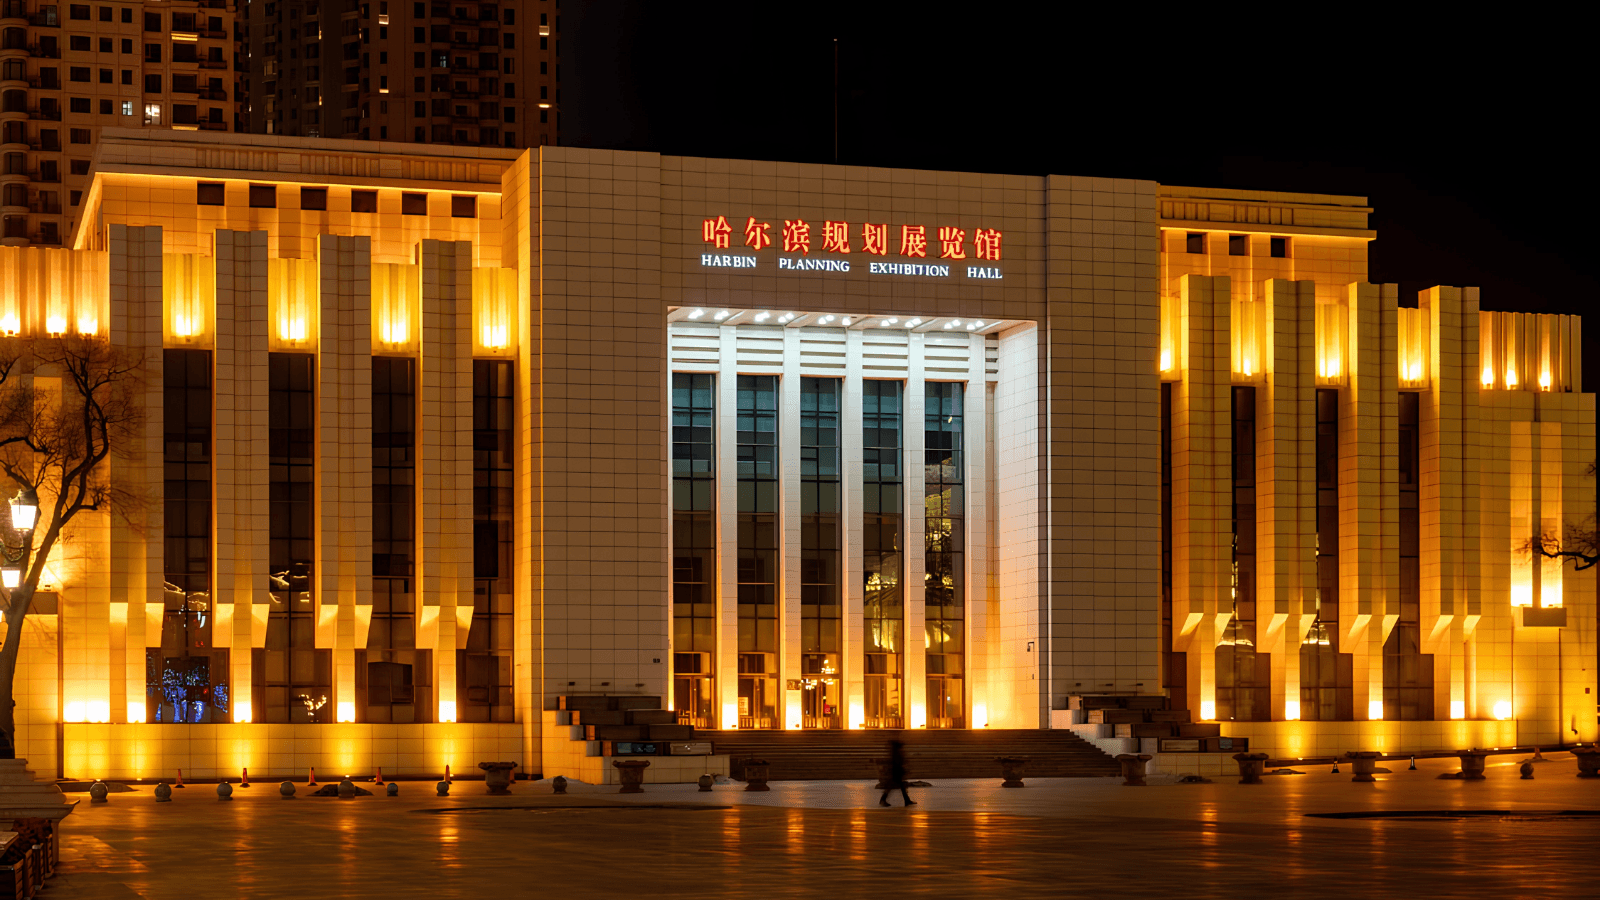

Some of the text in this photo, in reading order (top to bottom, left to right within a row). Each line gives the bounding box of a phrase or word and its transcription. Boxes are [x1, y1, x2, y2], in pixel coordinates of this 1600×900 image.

[701, 215, 1003, 261] 哈尔滨规划展览馆
[701, 254, 1003, 279] HARBIN PLANNING EXHIBITION HALL
